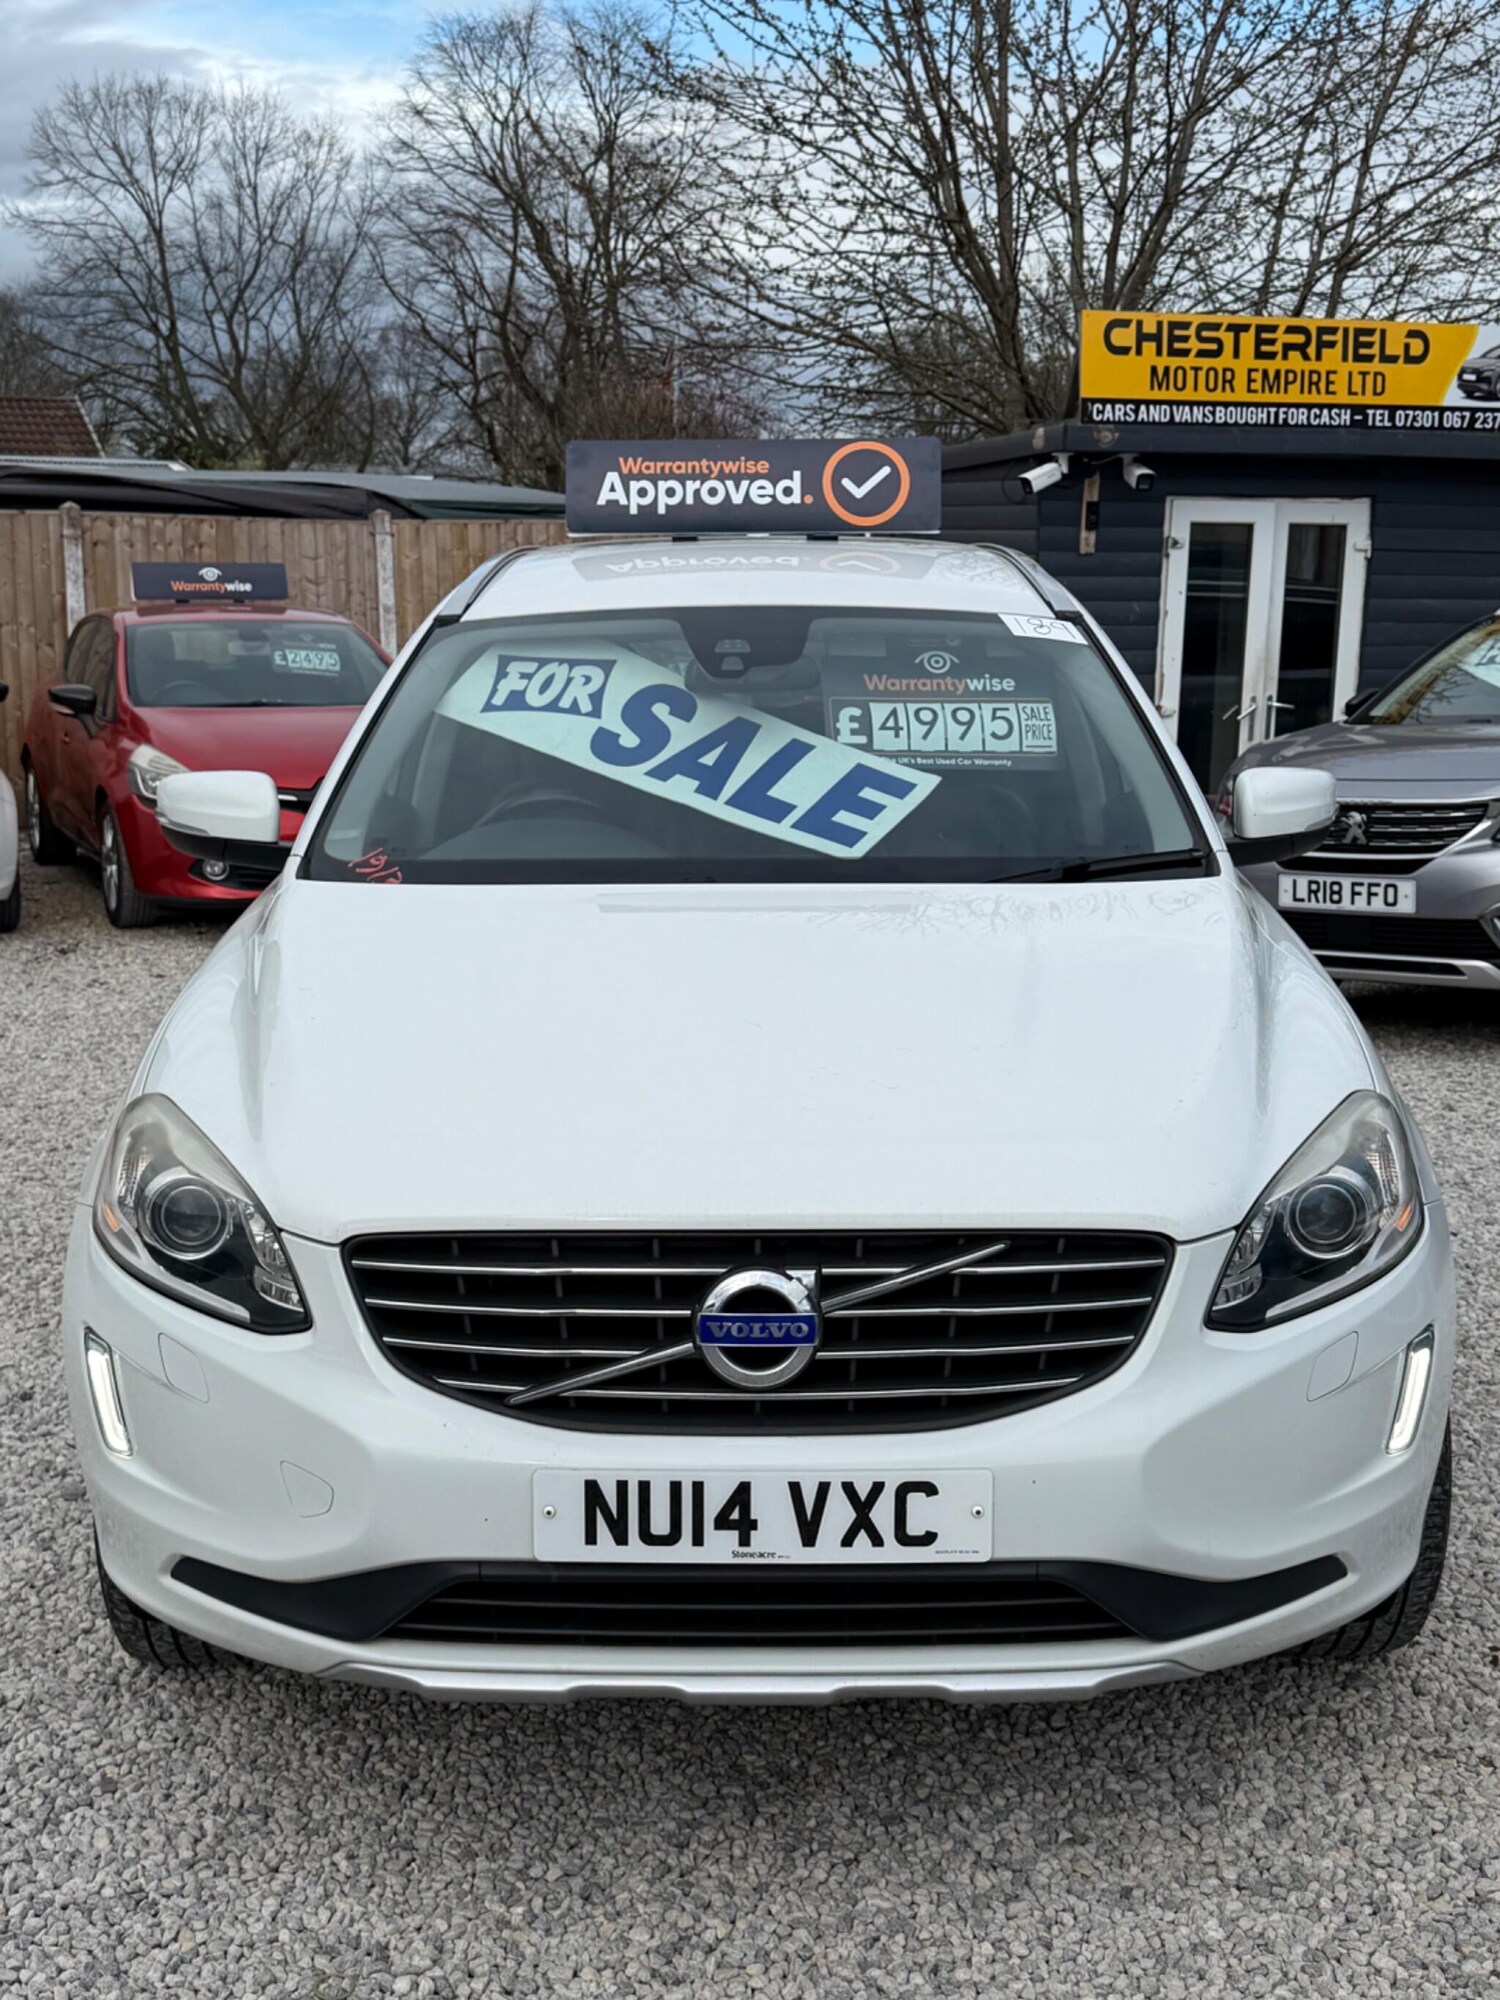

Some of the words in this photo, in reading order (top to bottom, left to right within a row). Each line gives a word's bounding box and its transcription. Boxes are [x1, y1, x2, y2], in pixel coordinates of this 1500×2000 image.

[1103, 318, 1431, 365] CHESTERFIELD
[1149, 365, 1235, 393] MOTOR
[1246, 368, 1336, 396] EMPIRE
[1347, 371, 1386, 397] LTD
[1092, 403, 1135, 422] CARS
[1137, 404, 1171, 423] AND
[1172, 405, 1214, 424] VANS
[1215, 406, 1278, 425] BOUGHT
[1278, 407, 1308, 426] FOR
[1310, 408, 1351, 427] CASH
[1366, 409, 1392, 427] TEL
[1395, 410, 1440, 428] 07301
[1443, 411, 1471, 429] 067
[618, 456, 770, 479] Warrantywise
[596, 470, 814, 514] Approved.
[170, 580, 253, 594] Warrantywise
[863, 674, 1016, 695] Warrantywise
[1021, 705, 1052, 722] SALE
[1024, 723, 1053, 741] PRICE
[489, 661, 605, 714] FOR
[590, 683, 919, 849] SALE
[1292, 879, 1343, 905] LR18
[1350, 882, 1398, 907] FFO
[706, 1322, 810, 1338] VOLVO
[584, 1479, 758, 1548] NU14
[787, 1480, 940, 1548] VXC
[731, 1549, 777, 1559] Stoneacre
